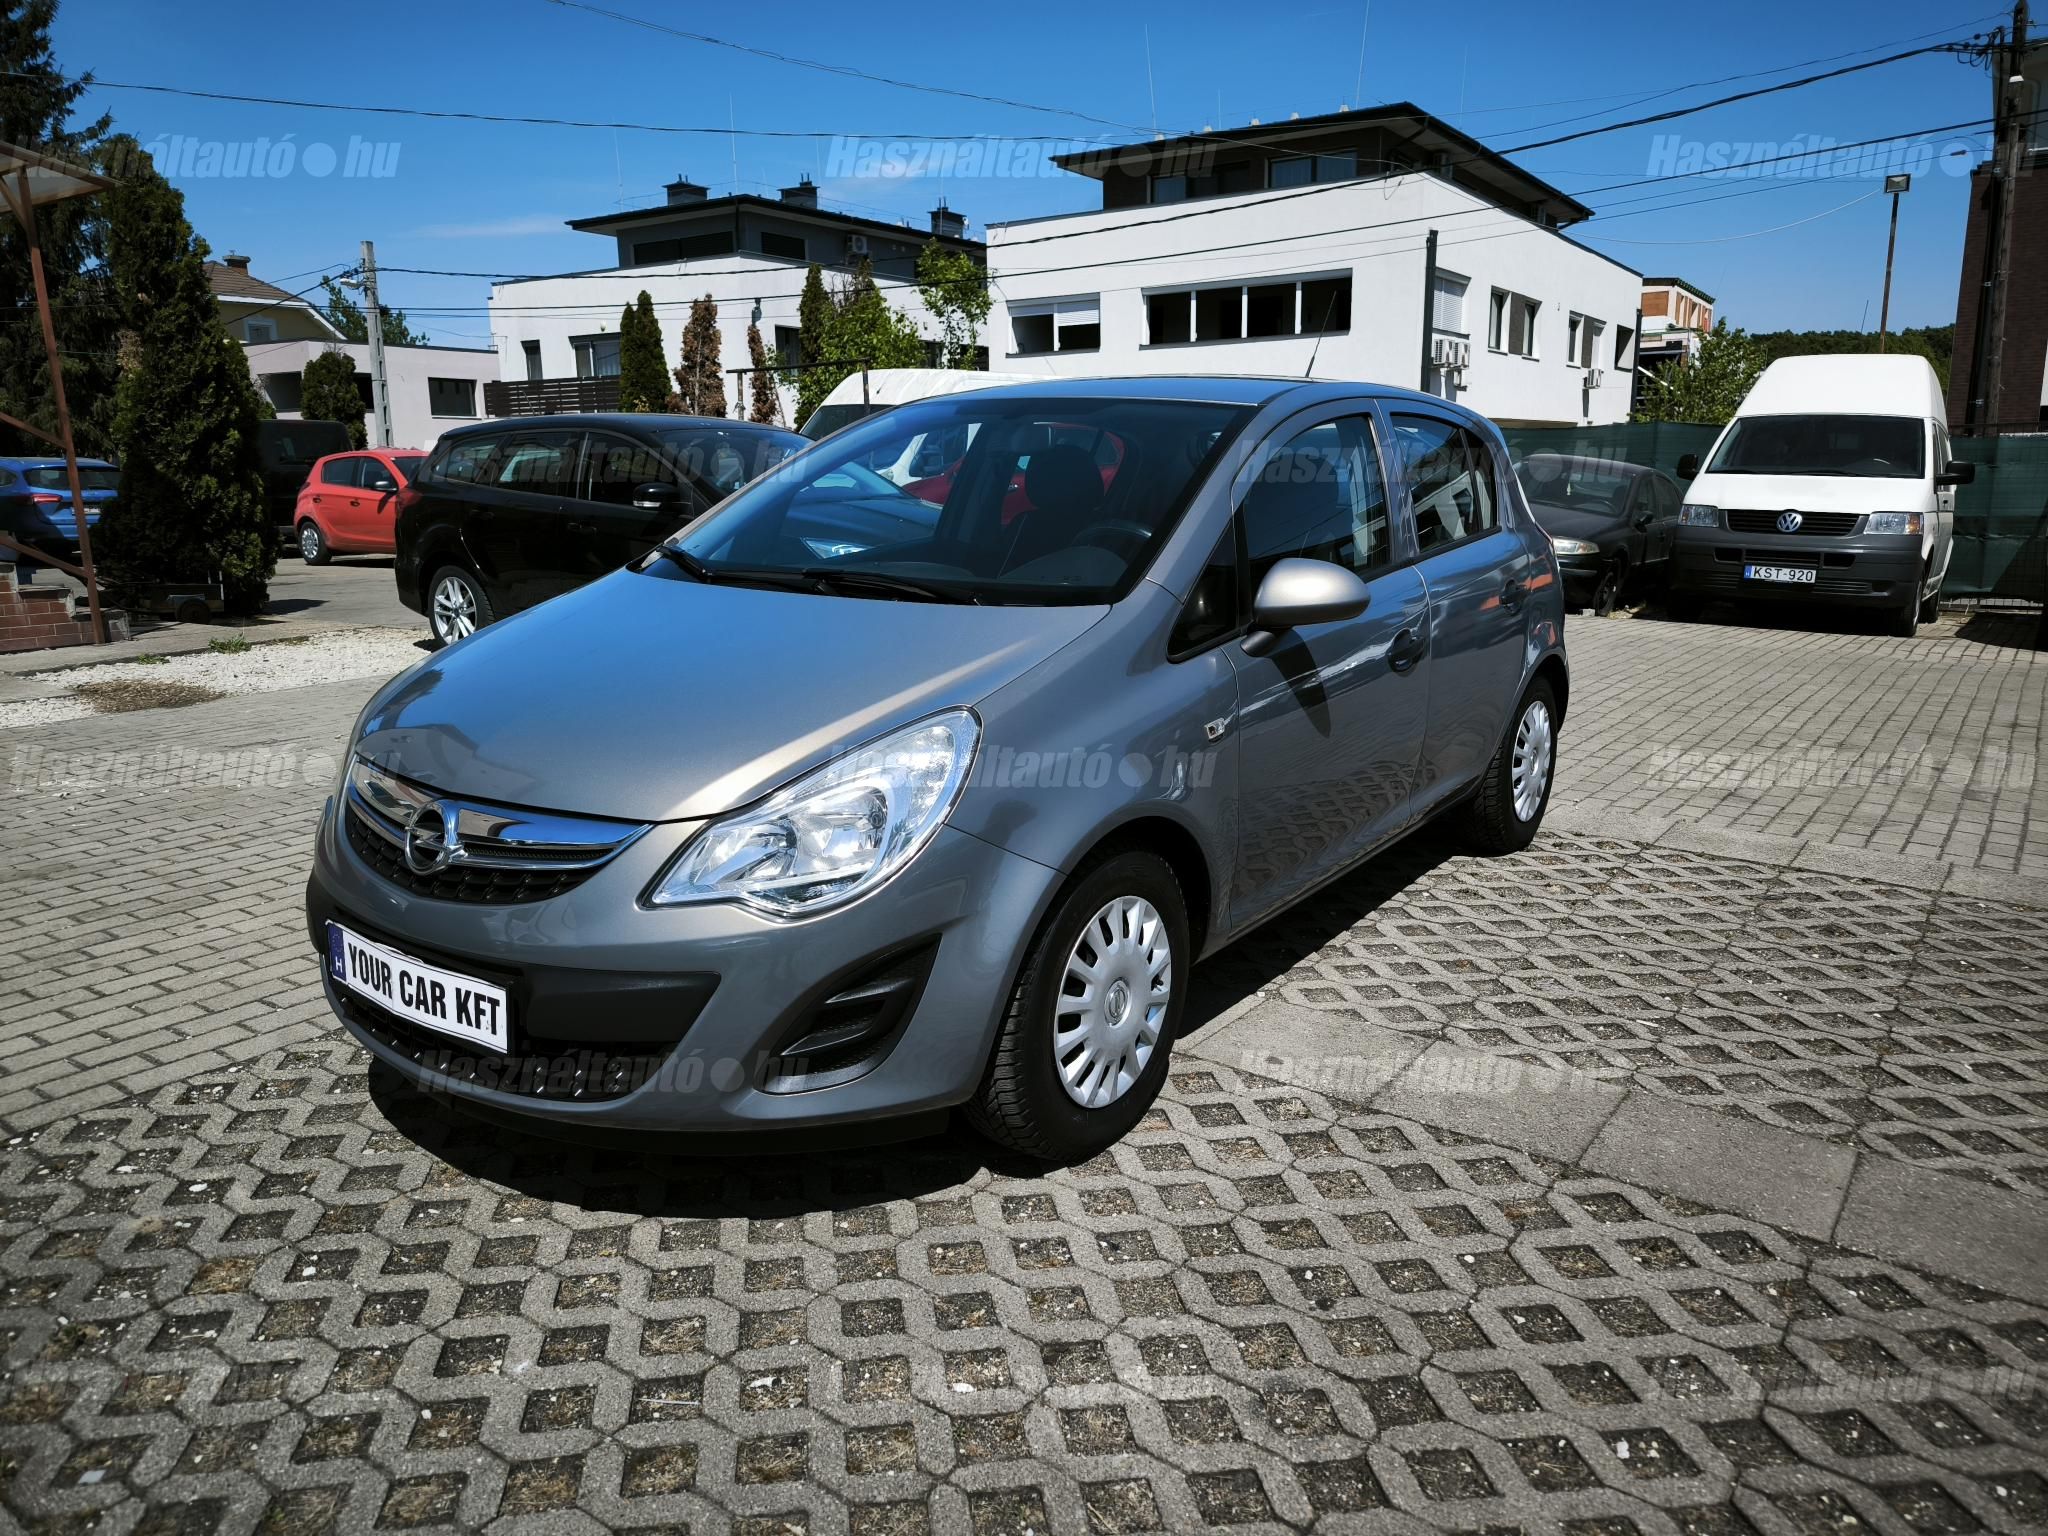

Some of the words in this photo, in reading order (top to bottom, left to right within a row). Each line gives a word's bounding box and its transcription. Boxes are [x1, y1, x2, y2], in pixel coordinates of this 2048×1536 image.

[1754, 567, 1813, 582] KST-920
[348, 943, 393, 1000] YOUR
[399, 970, 447, 1020] CAR
[456, 987, 500, 1036] KFT
